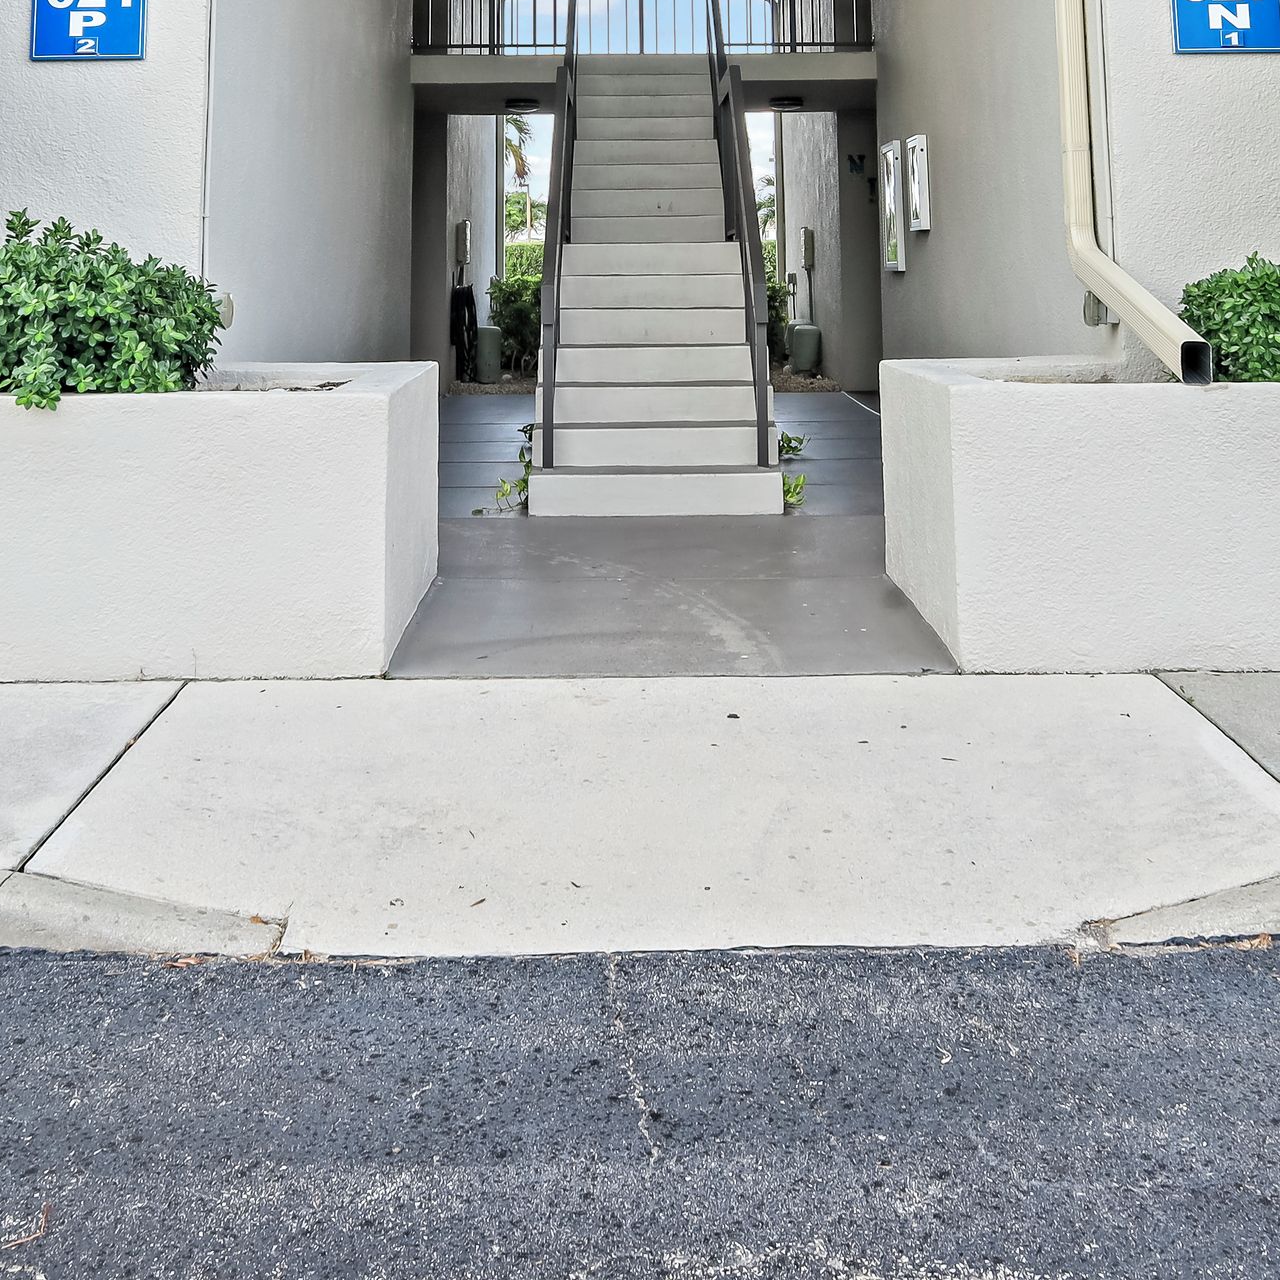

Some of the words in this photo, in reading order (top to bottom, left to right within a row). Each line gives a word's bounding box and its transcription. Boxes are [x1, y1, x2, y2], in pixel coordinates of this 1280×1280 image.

[69, 11, 107, 37] P
[1208, 4, 1251, 29] N
[77, 39, 96, 53] 2
[1225, 32, 1239, 46] 1
